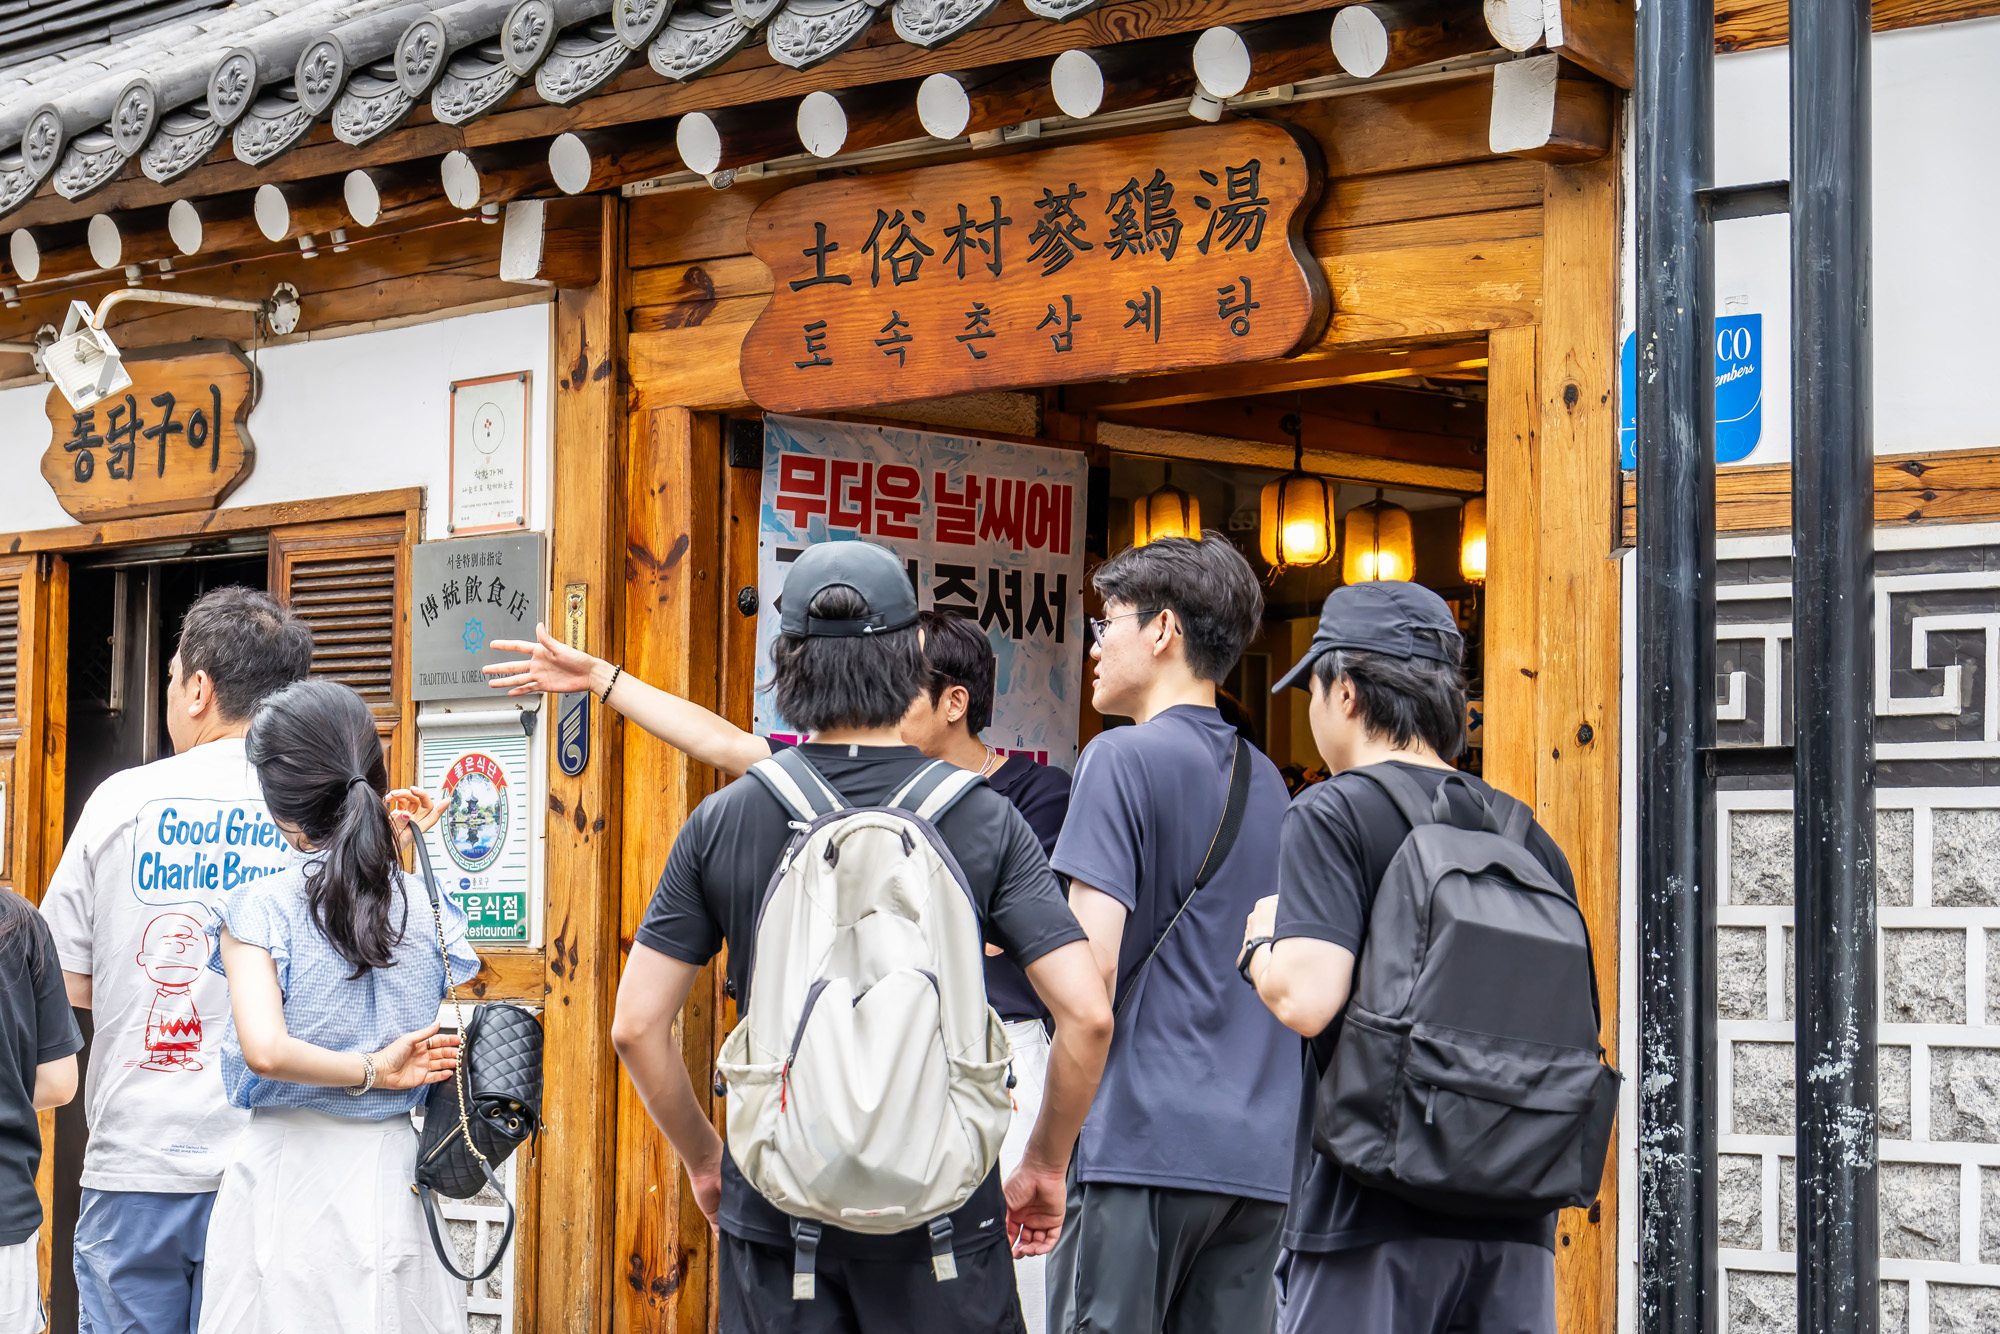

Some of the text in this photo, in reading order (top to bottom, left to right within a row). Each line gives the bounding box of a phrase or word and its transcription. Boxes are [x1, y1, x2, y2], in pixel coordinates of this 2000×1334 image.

[1716, 327, 1752, 362] CO
[1715, 363, 1756, 388] embers
[63, 383, 221, 483] 통닭구이
[776, 454, 1073, 555] 무더운 날씨에
[419, 670, 459, 686] TRADITIONAL
[461, 669, 486, 684] KOREAN
[158, 807, 224, 846] Good
[138, 851, 286, 891] Charlie Bro
